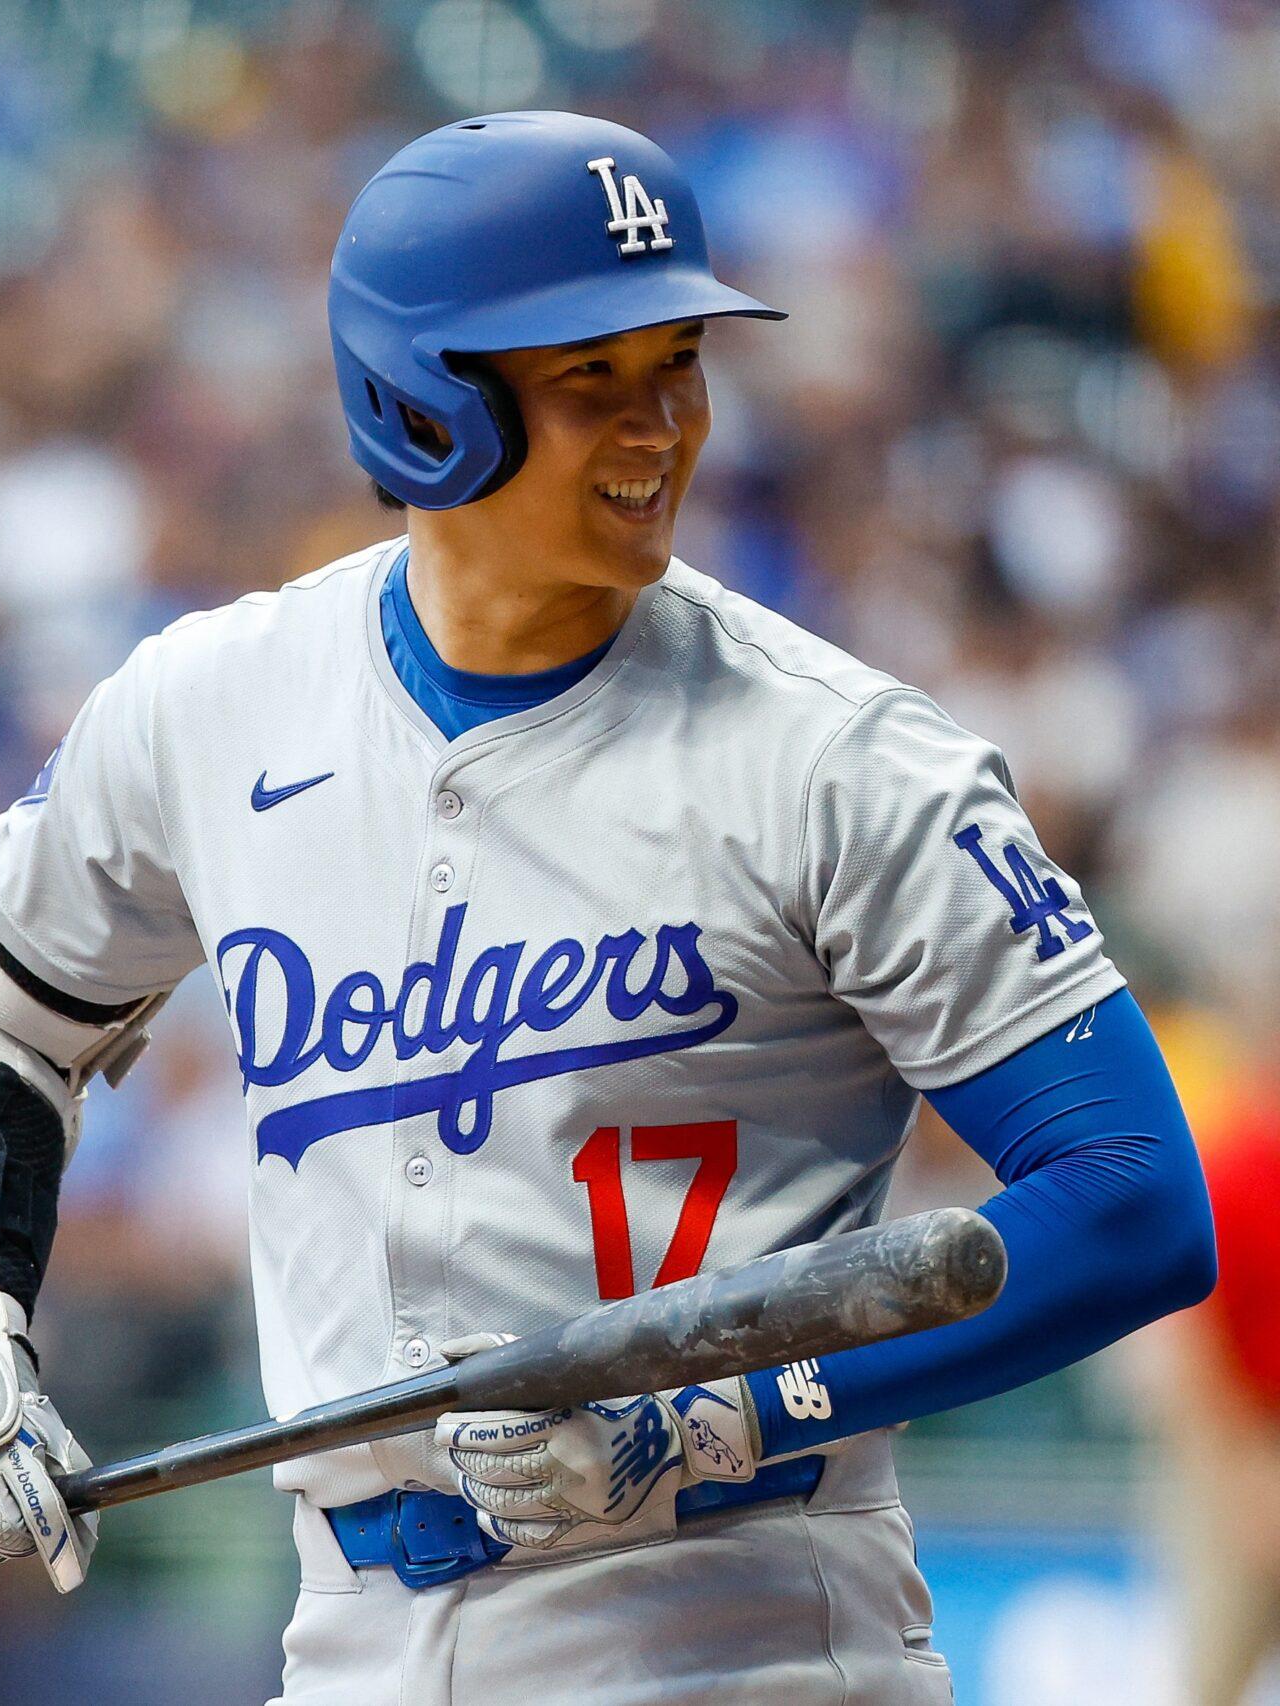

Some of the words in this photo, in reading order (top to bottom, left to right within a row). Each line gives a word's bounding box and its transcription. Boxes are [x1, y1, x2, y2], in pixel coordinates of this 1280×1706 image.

[586, 157, 674, 254] LA
[953, 823, 1094, 963] LA
[217, 901, 730, 1160] Dodgers
[572, 1119, 738, 1301] 17
[470, 1428, 499, 1442] new
[502, 1408, 573, 1440] balance
[16, 1471, 52, 1538] balance
